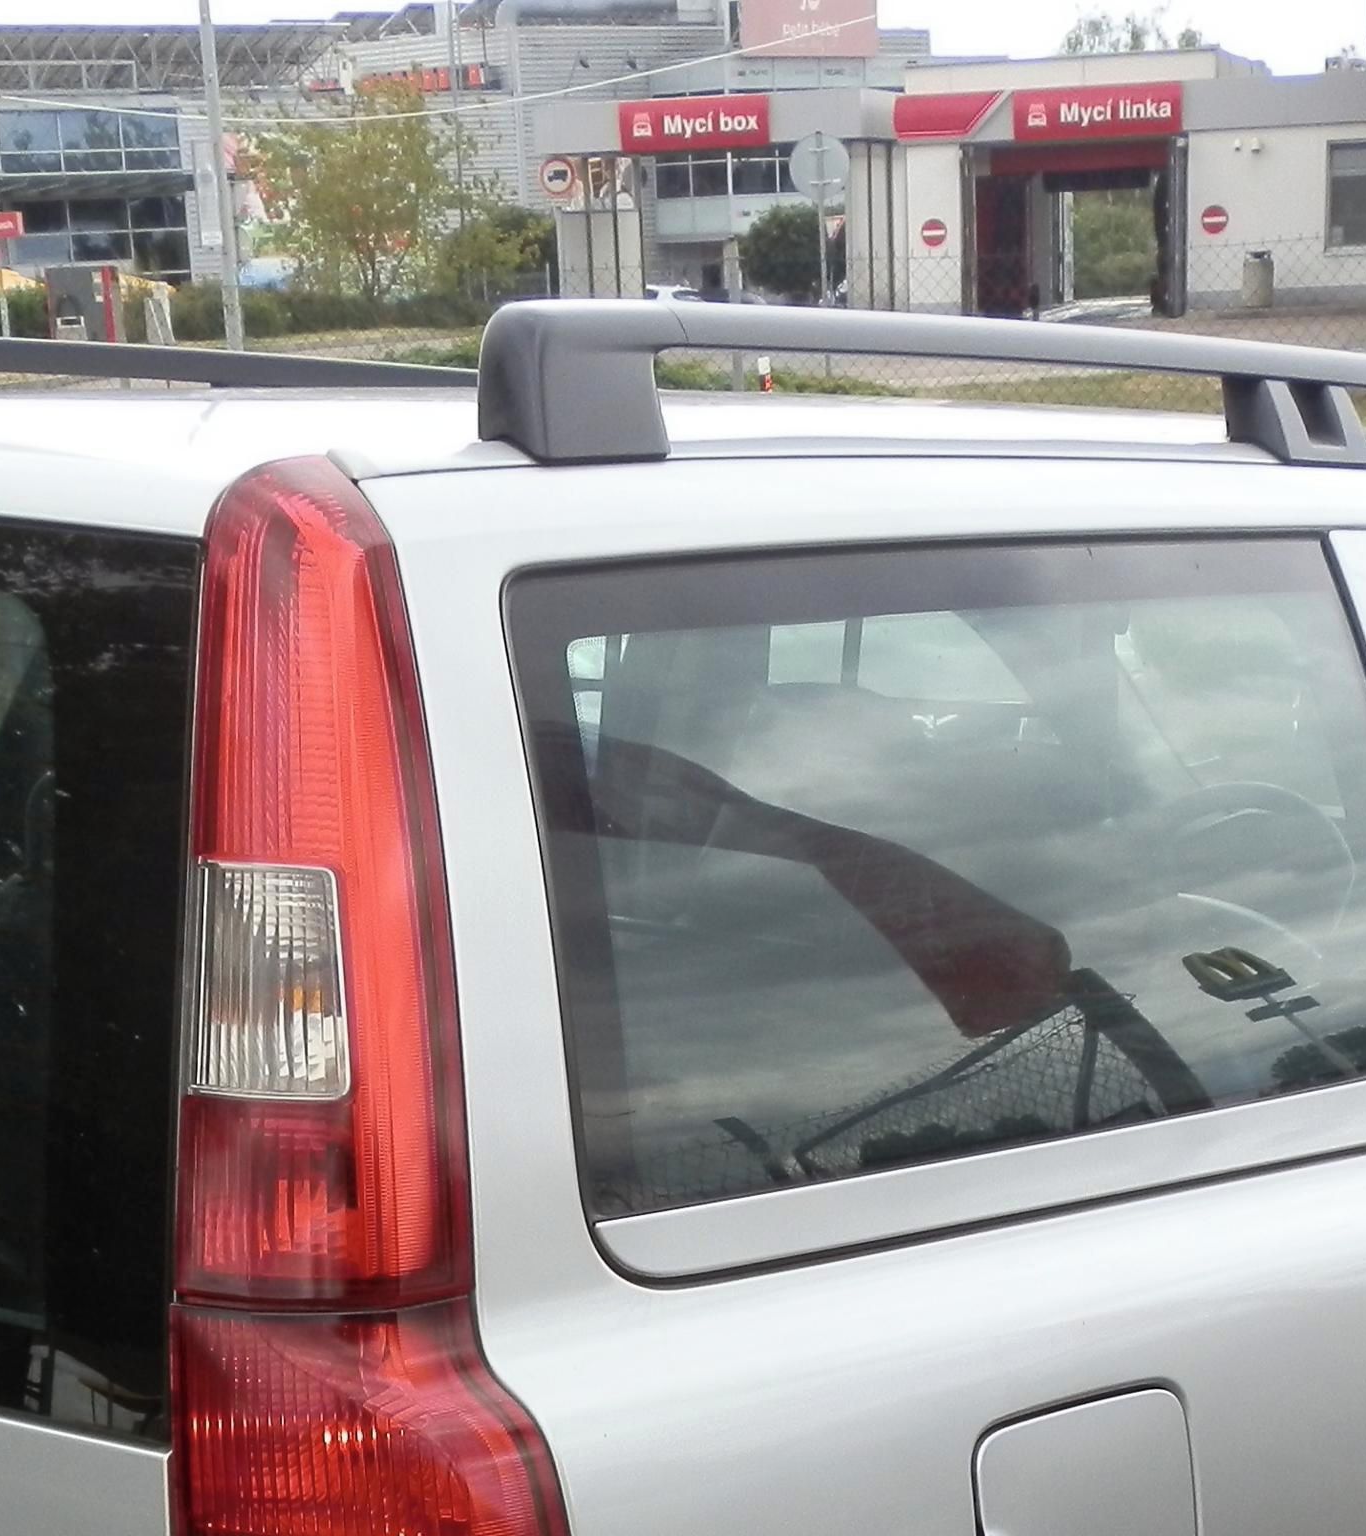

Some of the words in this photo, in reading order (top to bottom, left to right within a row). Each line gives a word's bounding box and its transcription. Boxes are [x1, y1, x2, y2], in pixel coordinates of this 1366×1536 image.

[663, 111, 714, 138] Mycí
[719, 108, 759, 132] box
[1060, 98, 1113, 127] Mycí
[1119, 98, 1172, 119] linka
